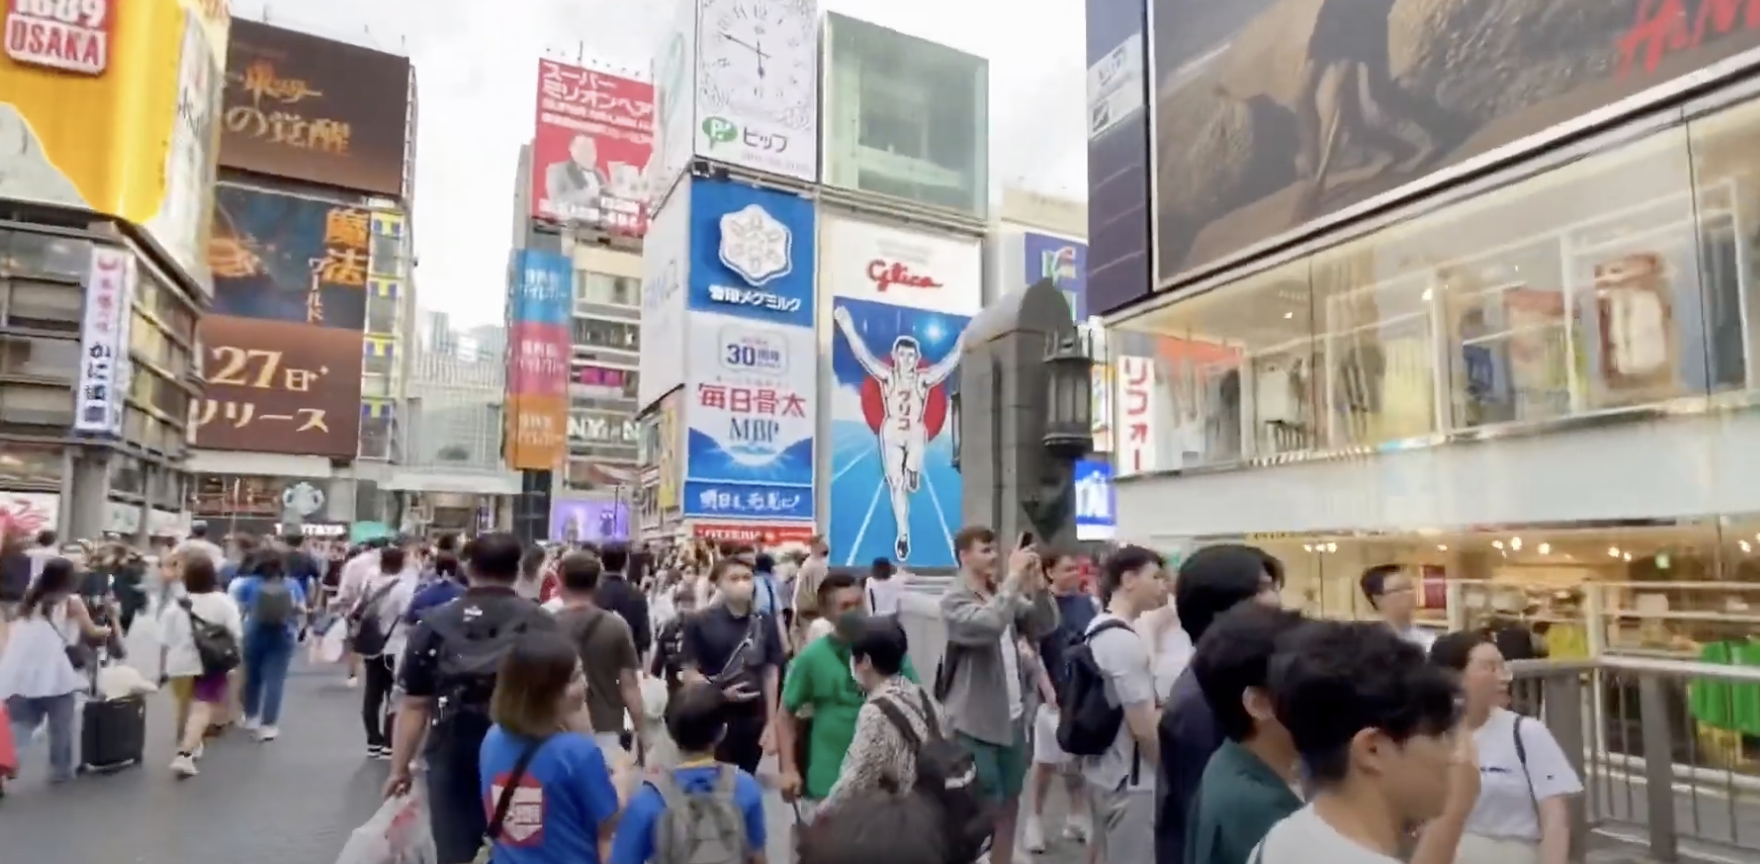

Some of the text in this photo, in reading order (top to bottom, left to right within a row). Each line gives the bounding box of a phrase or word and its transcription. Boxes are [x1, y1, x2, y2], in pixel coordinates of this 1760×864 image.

[10, 20, 98, 67] OSAKA
[543, 62, 616, 90] スーパー
[226, 105, 351, 156] の覚醒
[325, 206, 369, 286] 魔法
[866, 259, 944, 292] Glico
[708, 284, 801, 312] 雪印メグミルク
[208, 345, 310, 392] 27日
[698, 382, 806, 418] 毎日骨太
